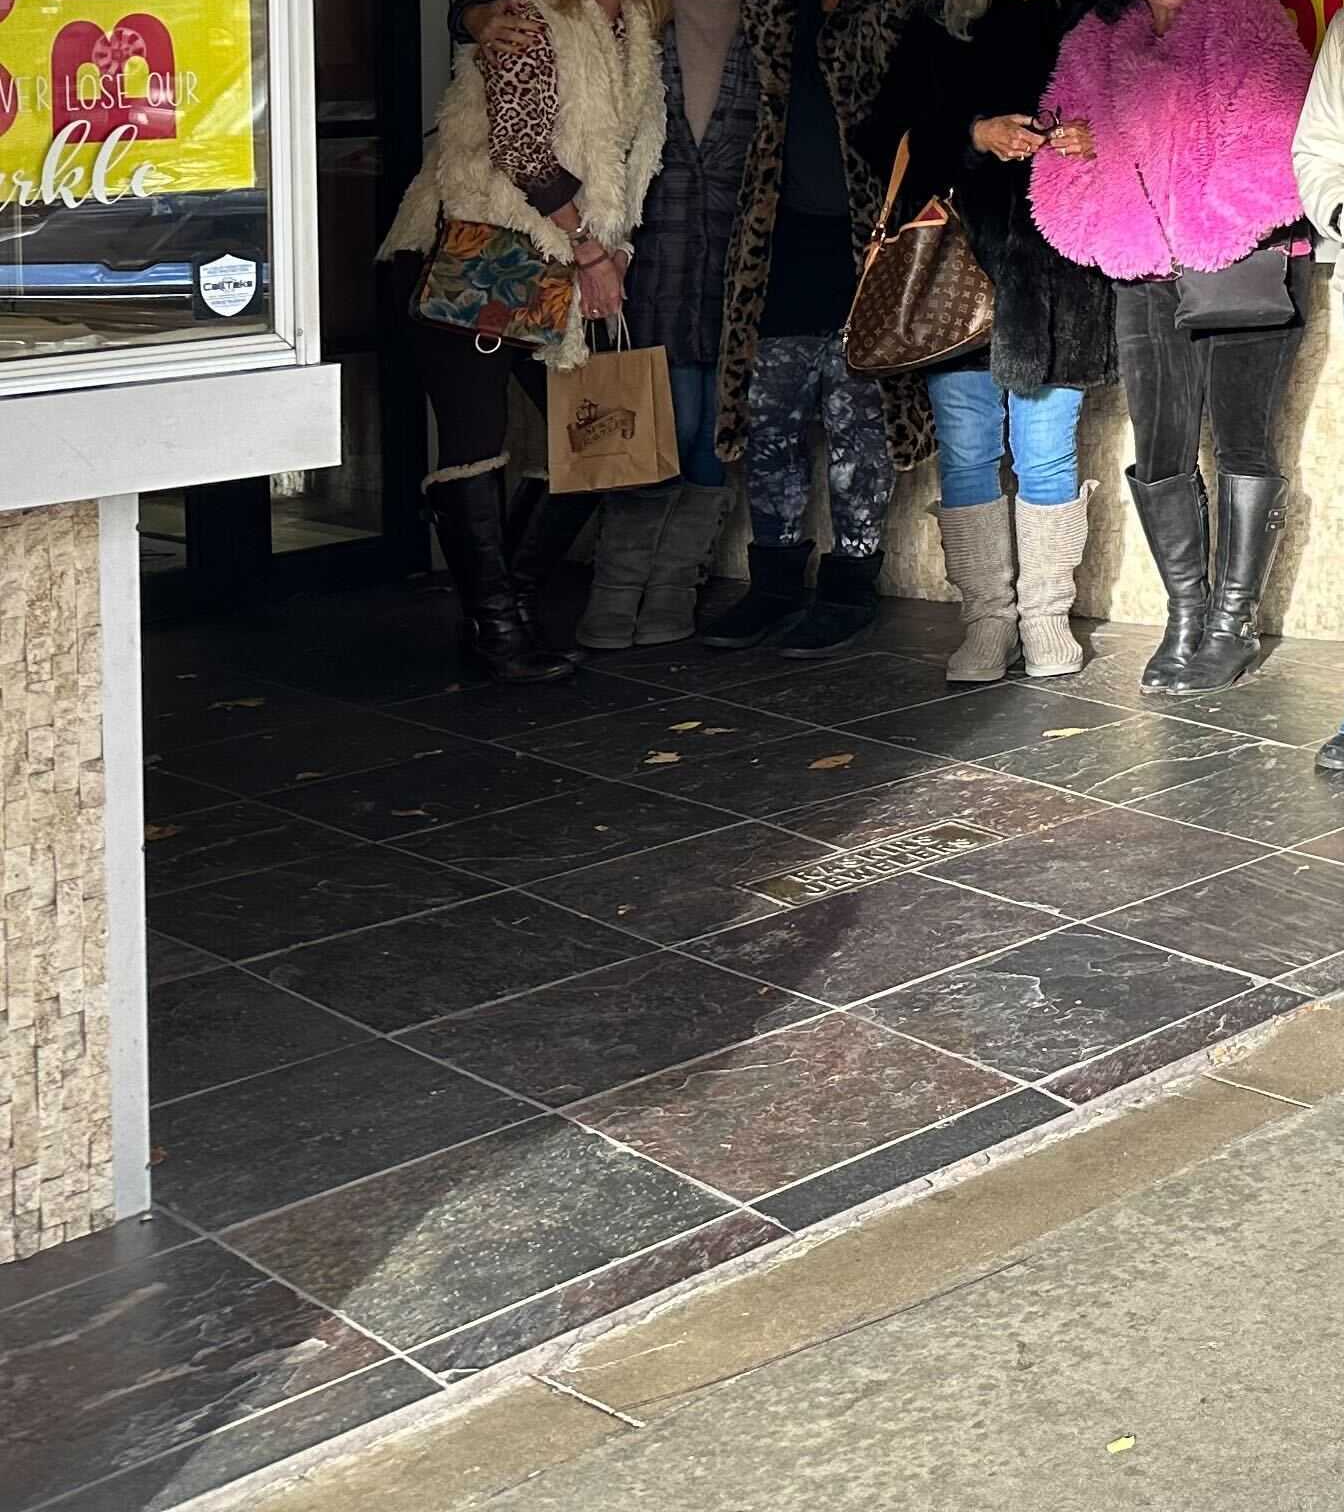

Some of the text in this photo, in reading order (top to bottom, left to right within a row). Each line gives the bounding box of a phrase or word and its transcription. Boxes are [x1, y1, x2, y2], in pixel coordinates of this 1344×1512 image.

[64, 73, 130, 113] LOSE
[145, 70, 201, 108] OUR
[805, 838, 978, 896] JEWELERS
